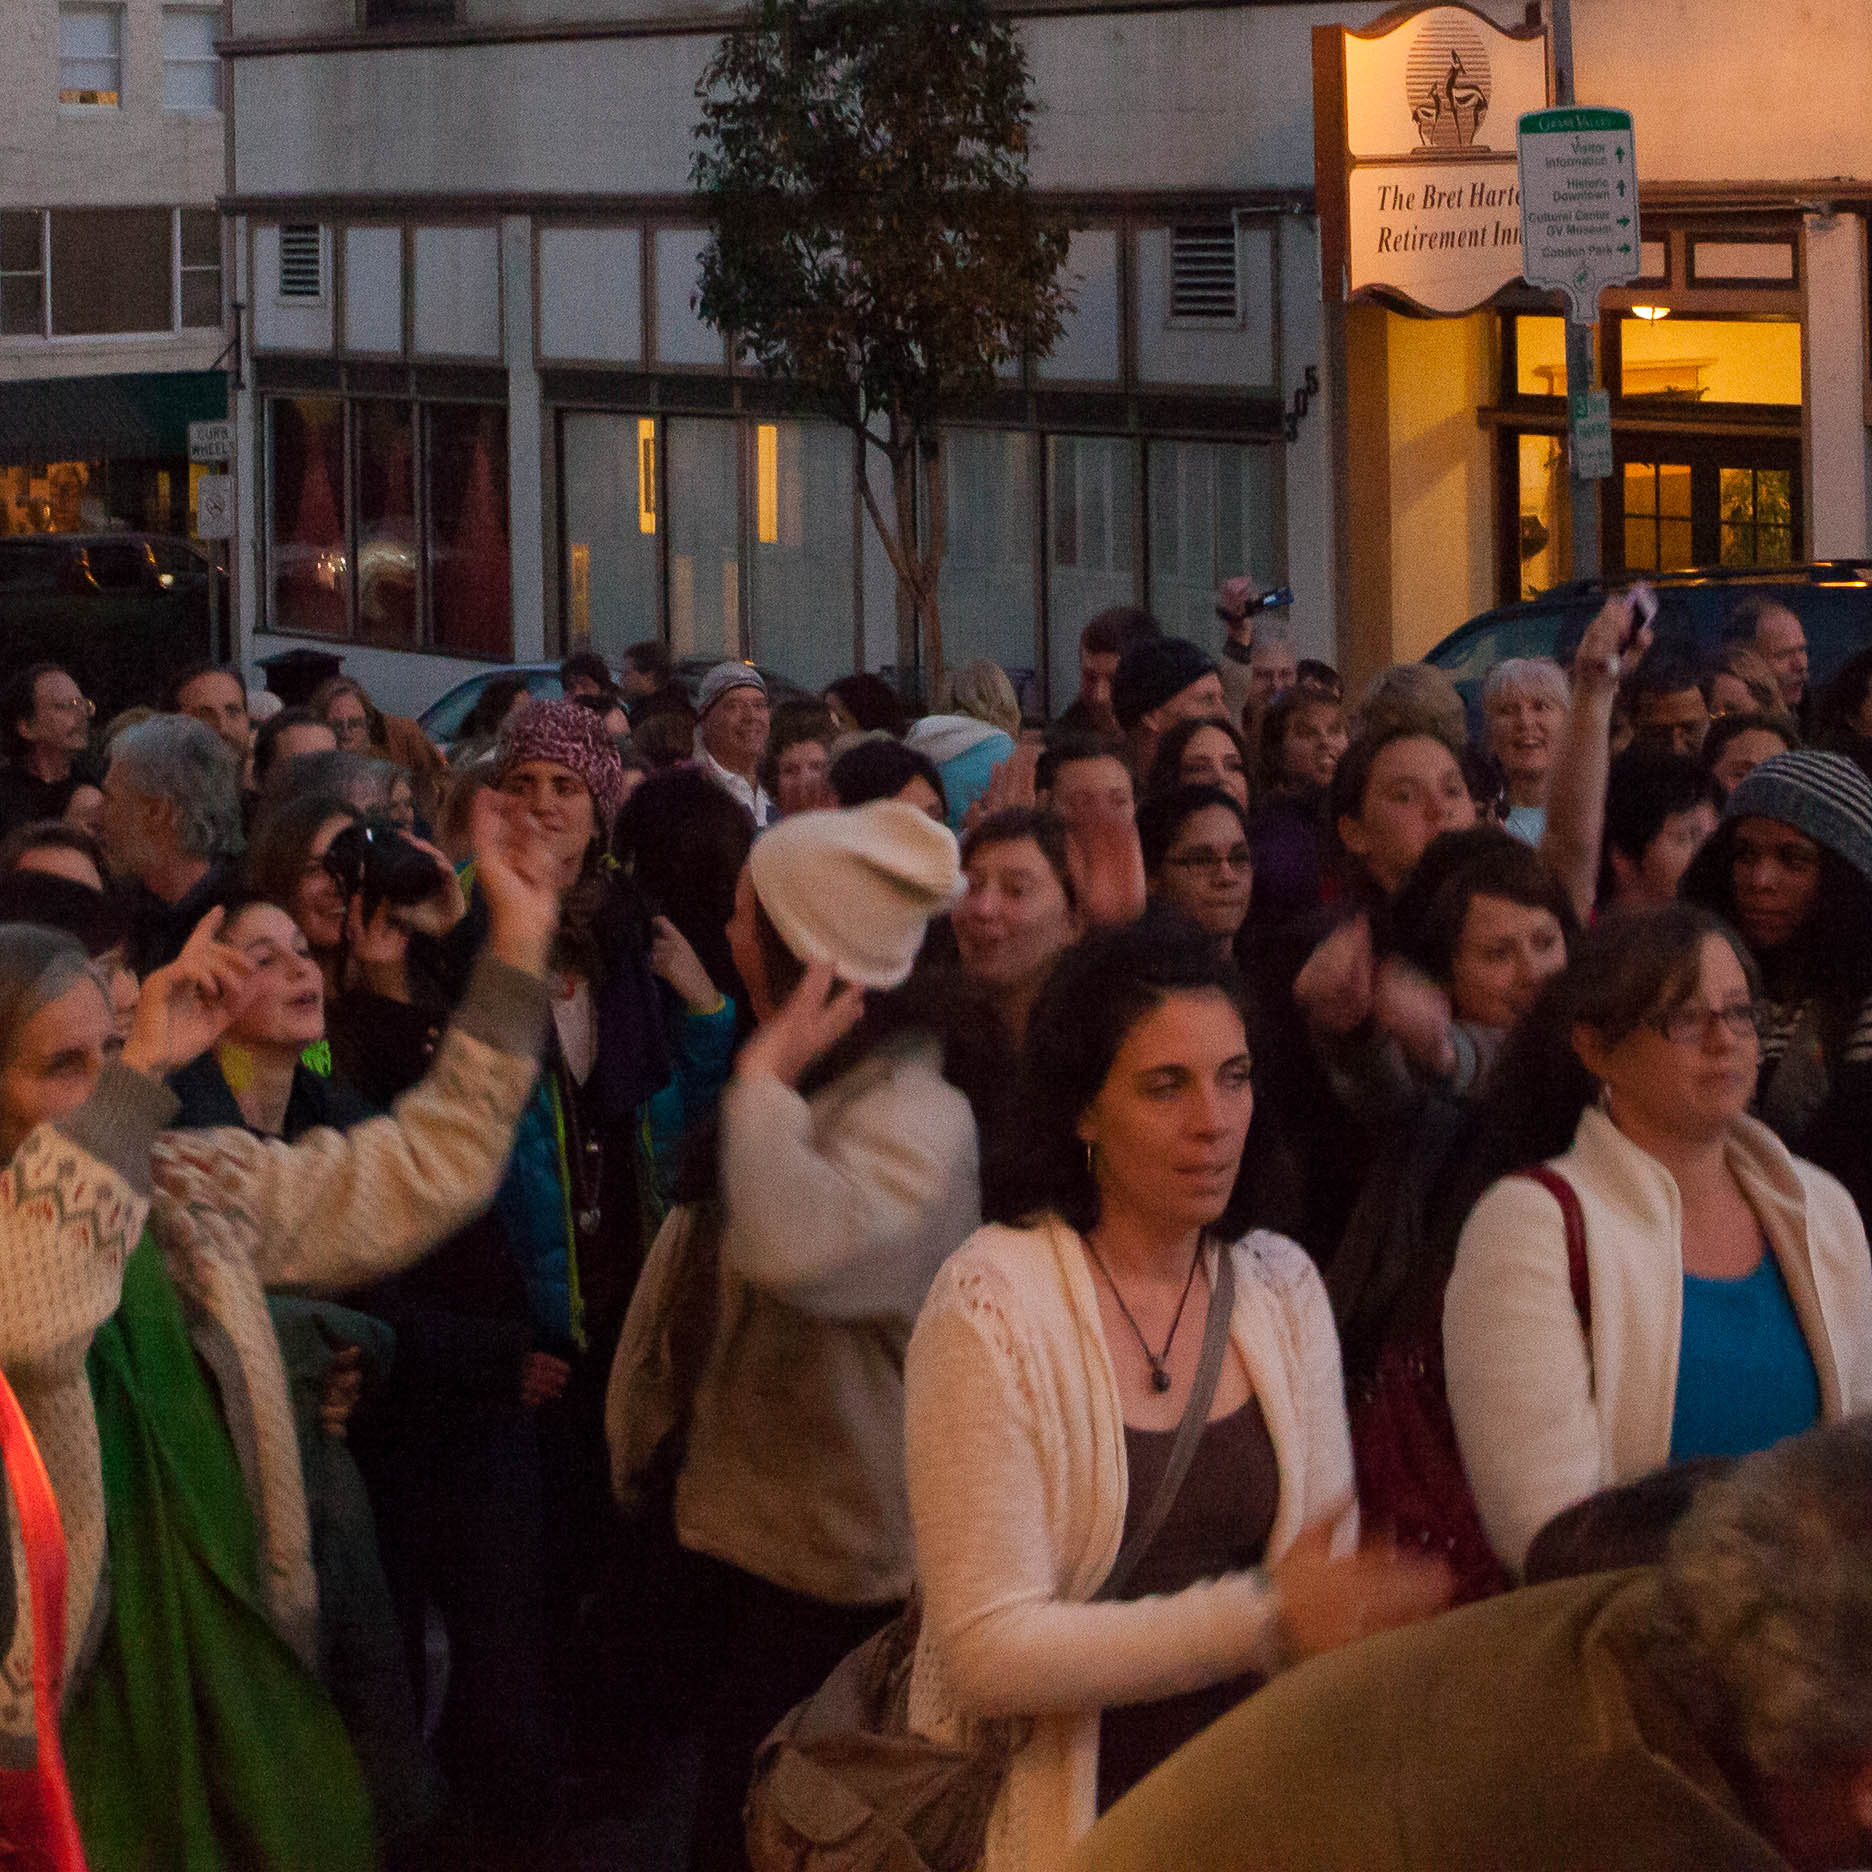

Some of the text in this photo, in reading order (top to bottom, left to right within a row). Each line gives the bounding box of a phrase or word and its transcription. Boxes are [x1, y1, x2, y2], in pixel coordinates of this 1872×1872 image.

[1572, 141, 1606, 154] Visitor
[1546, 155, 1608, 169] Information
[1568, 178, 1609, 190] Historic
[1377, 184, 1415, 211] The
[1422, 183, 1463, 210] Bret
[1553, 190, 1610, 203] Downtown
[1528, 209, 1611, 224] Cultural Center
[1377, 220, 1522, 253] Retirement Inn
[1588, 243, 1613, 256] Park
